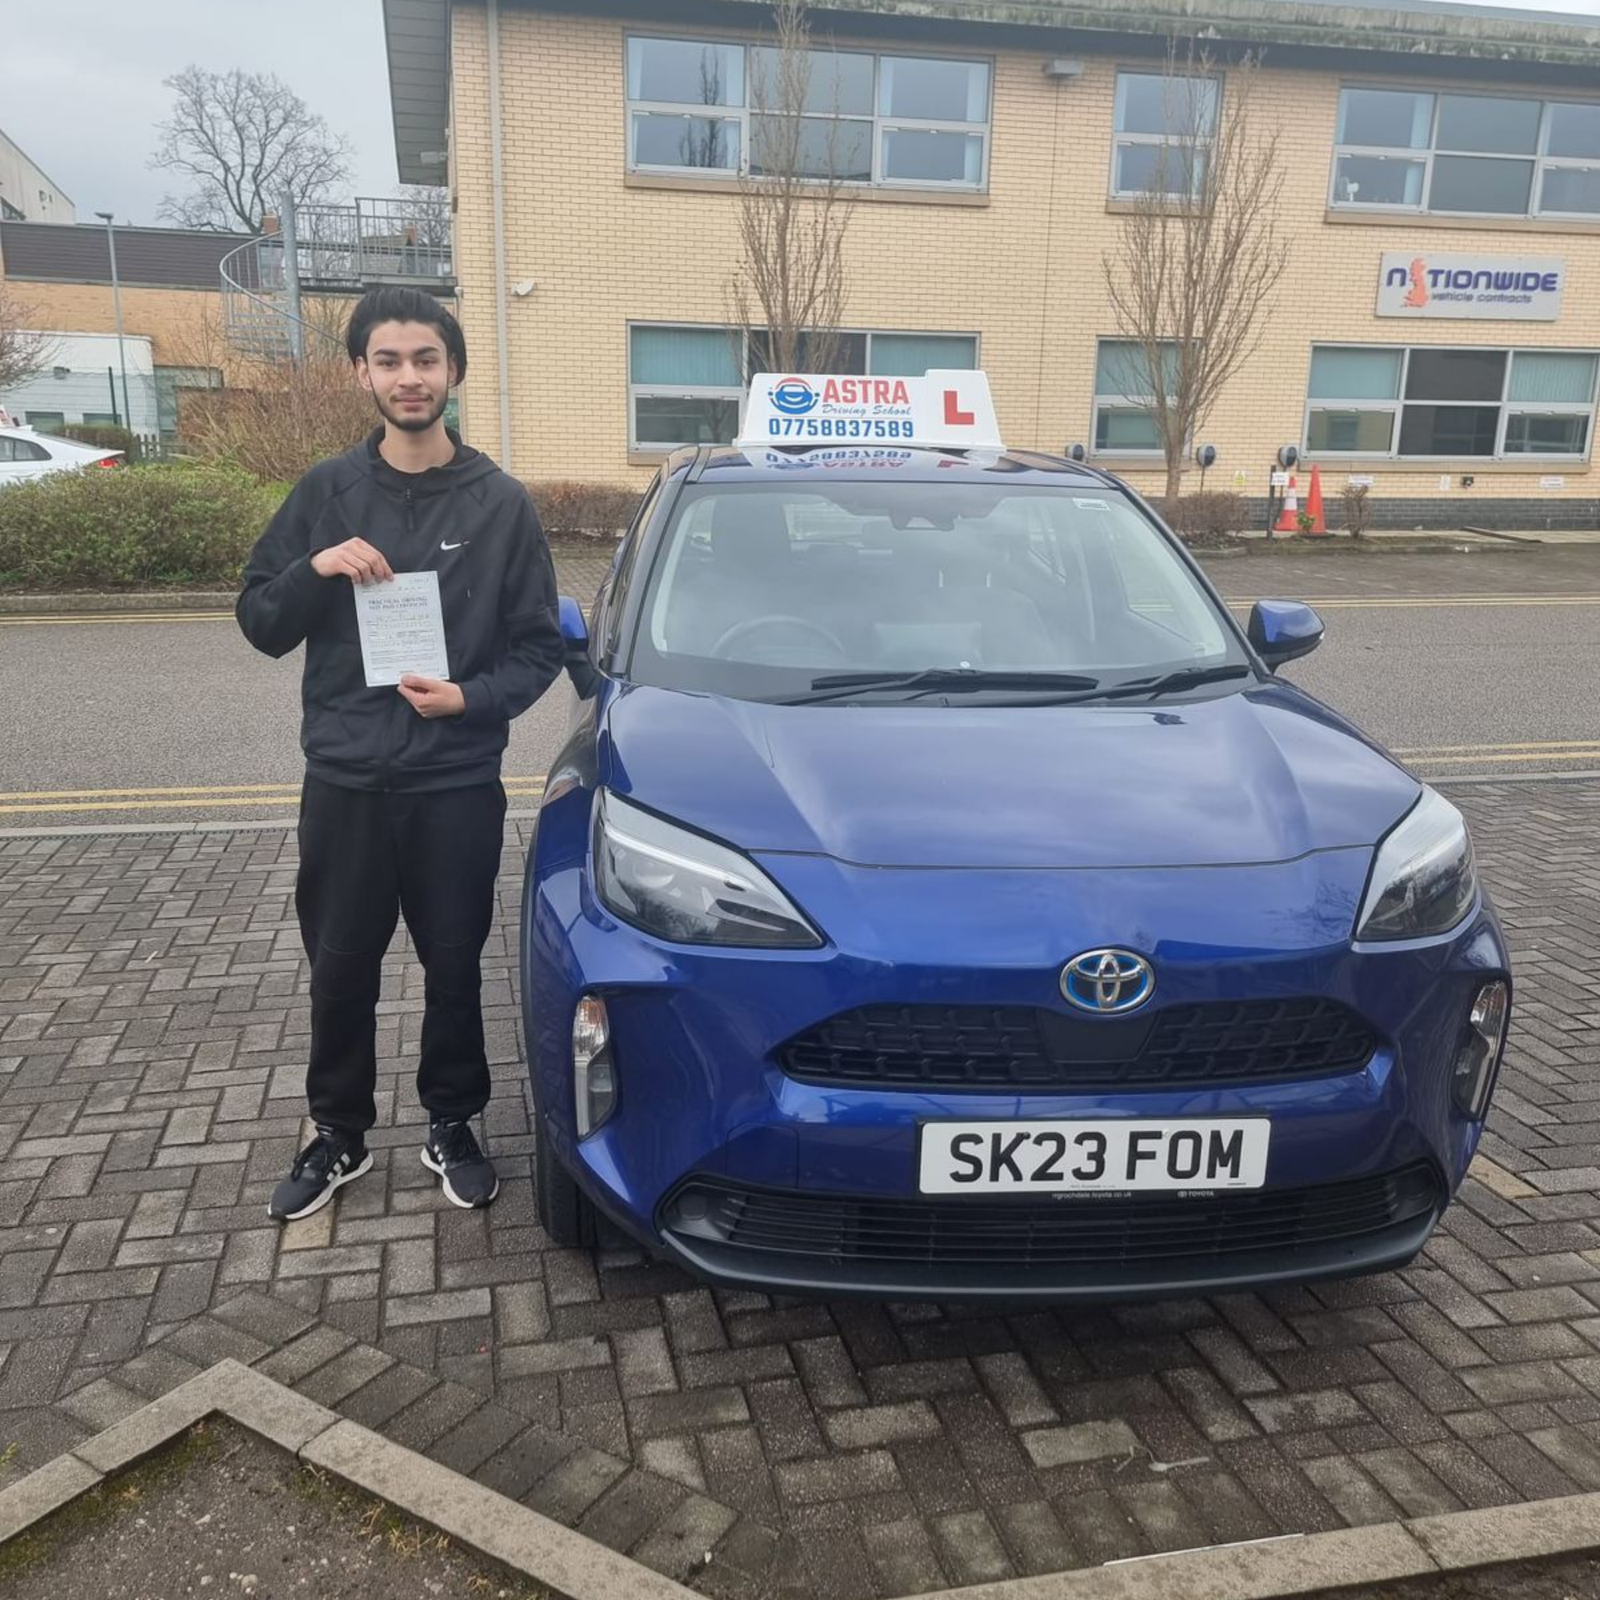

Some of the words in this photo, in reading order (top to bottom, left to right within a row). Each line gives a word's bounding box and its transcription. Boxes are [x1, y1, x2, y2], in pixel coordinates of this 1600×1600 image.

[1431, 292, 1474, 302] vehicle
[1476, 293, 1532, 304] contracts
[822, 378, 909, 405] ASTRA
[822, 404, 868, 417] Driving
[873, 404, 914, 416] School
[943, 390, 975, 425] L
[769, 418, 914, 438] 07758837589
[949, 1131, 1108, 1183] SK23
[1125, 1129, 1244, 1181] FOM
